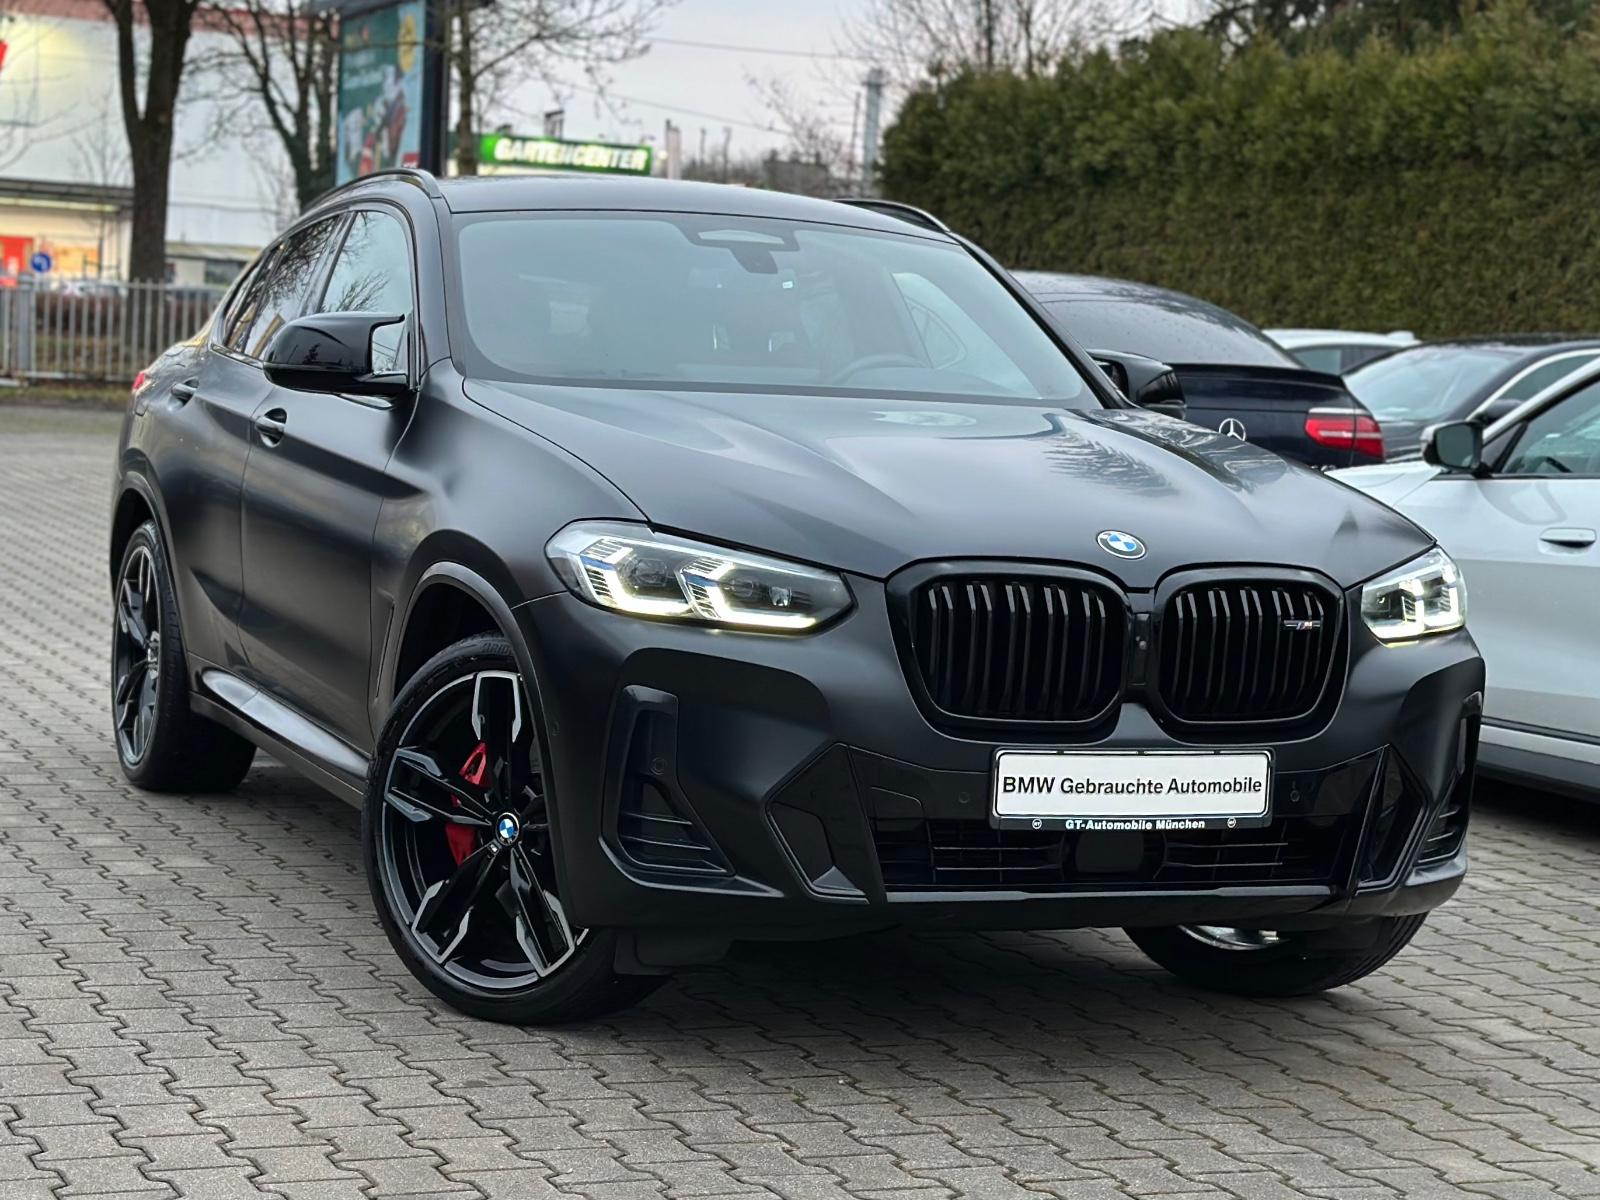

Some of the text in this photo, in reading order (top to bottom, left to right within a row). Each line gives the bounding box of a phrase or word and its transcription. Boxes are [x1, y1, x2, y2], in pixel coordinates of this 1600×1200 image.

[1003, 777, 1262, 794] BMW Gebrauchte Automobile
[1065, 819, 1206, 830] GT-Automobile München
